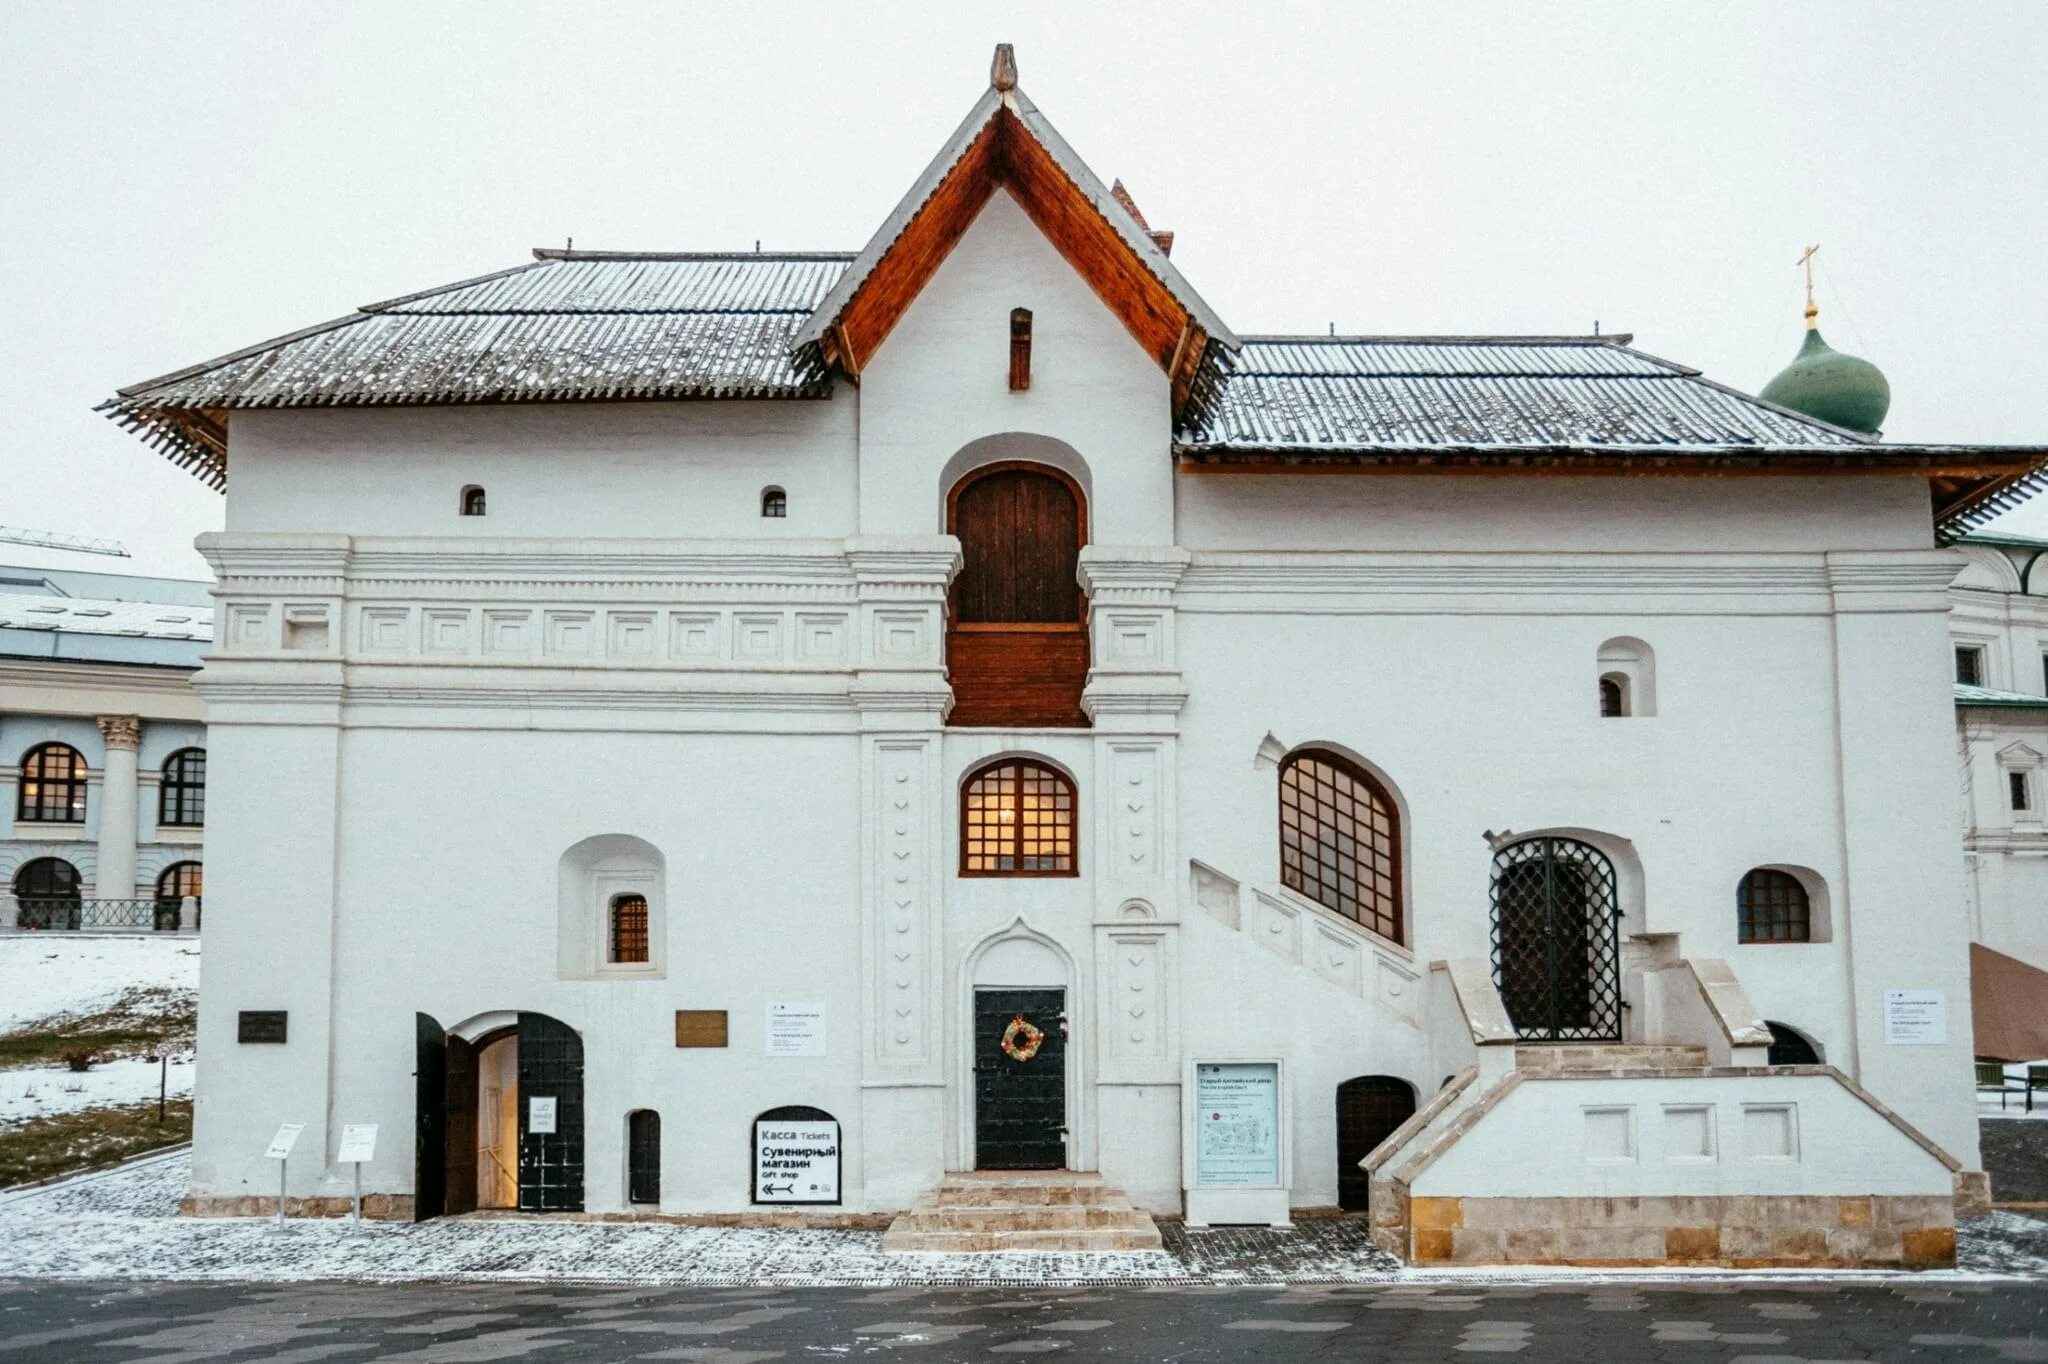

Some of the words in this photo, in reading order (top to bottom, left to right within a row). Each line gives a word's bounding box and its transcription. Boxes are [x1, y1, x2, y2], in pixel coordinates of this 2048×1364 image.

[762, 1130, 797, 1140] Касса
[800, 1132, 831, 1140] Tickets
[762, 1146, 836, 1159] Сувенирный
[762, 1160, 810, 1168] магазин
[781, 1171, 799, 1179] shop
